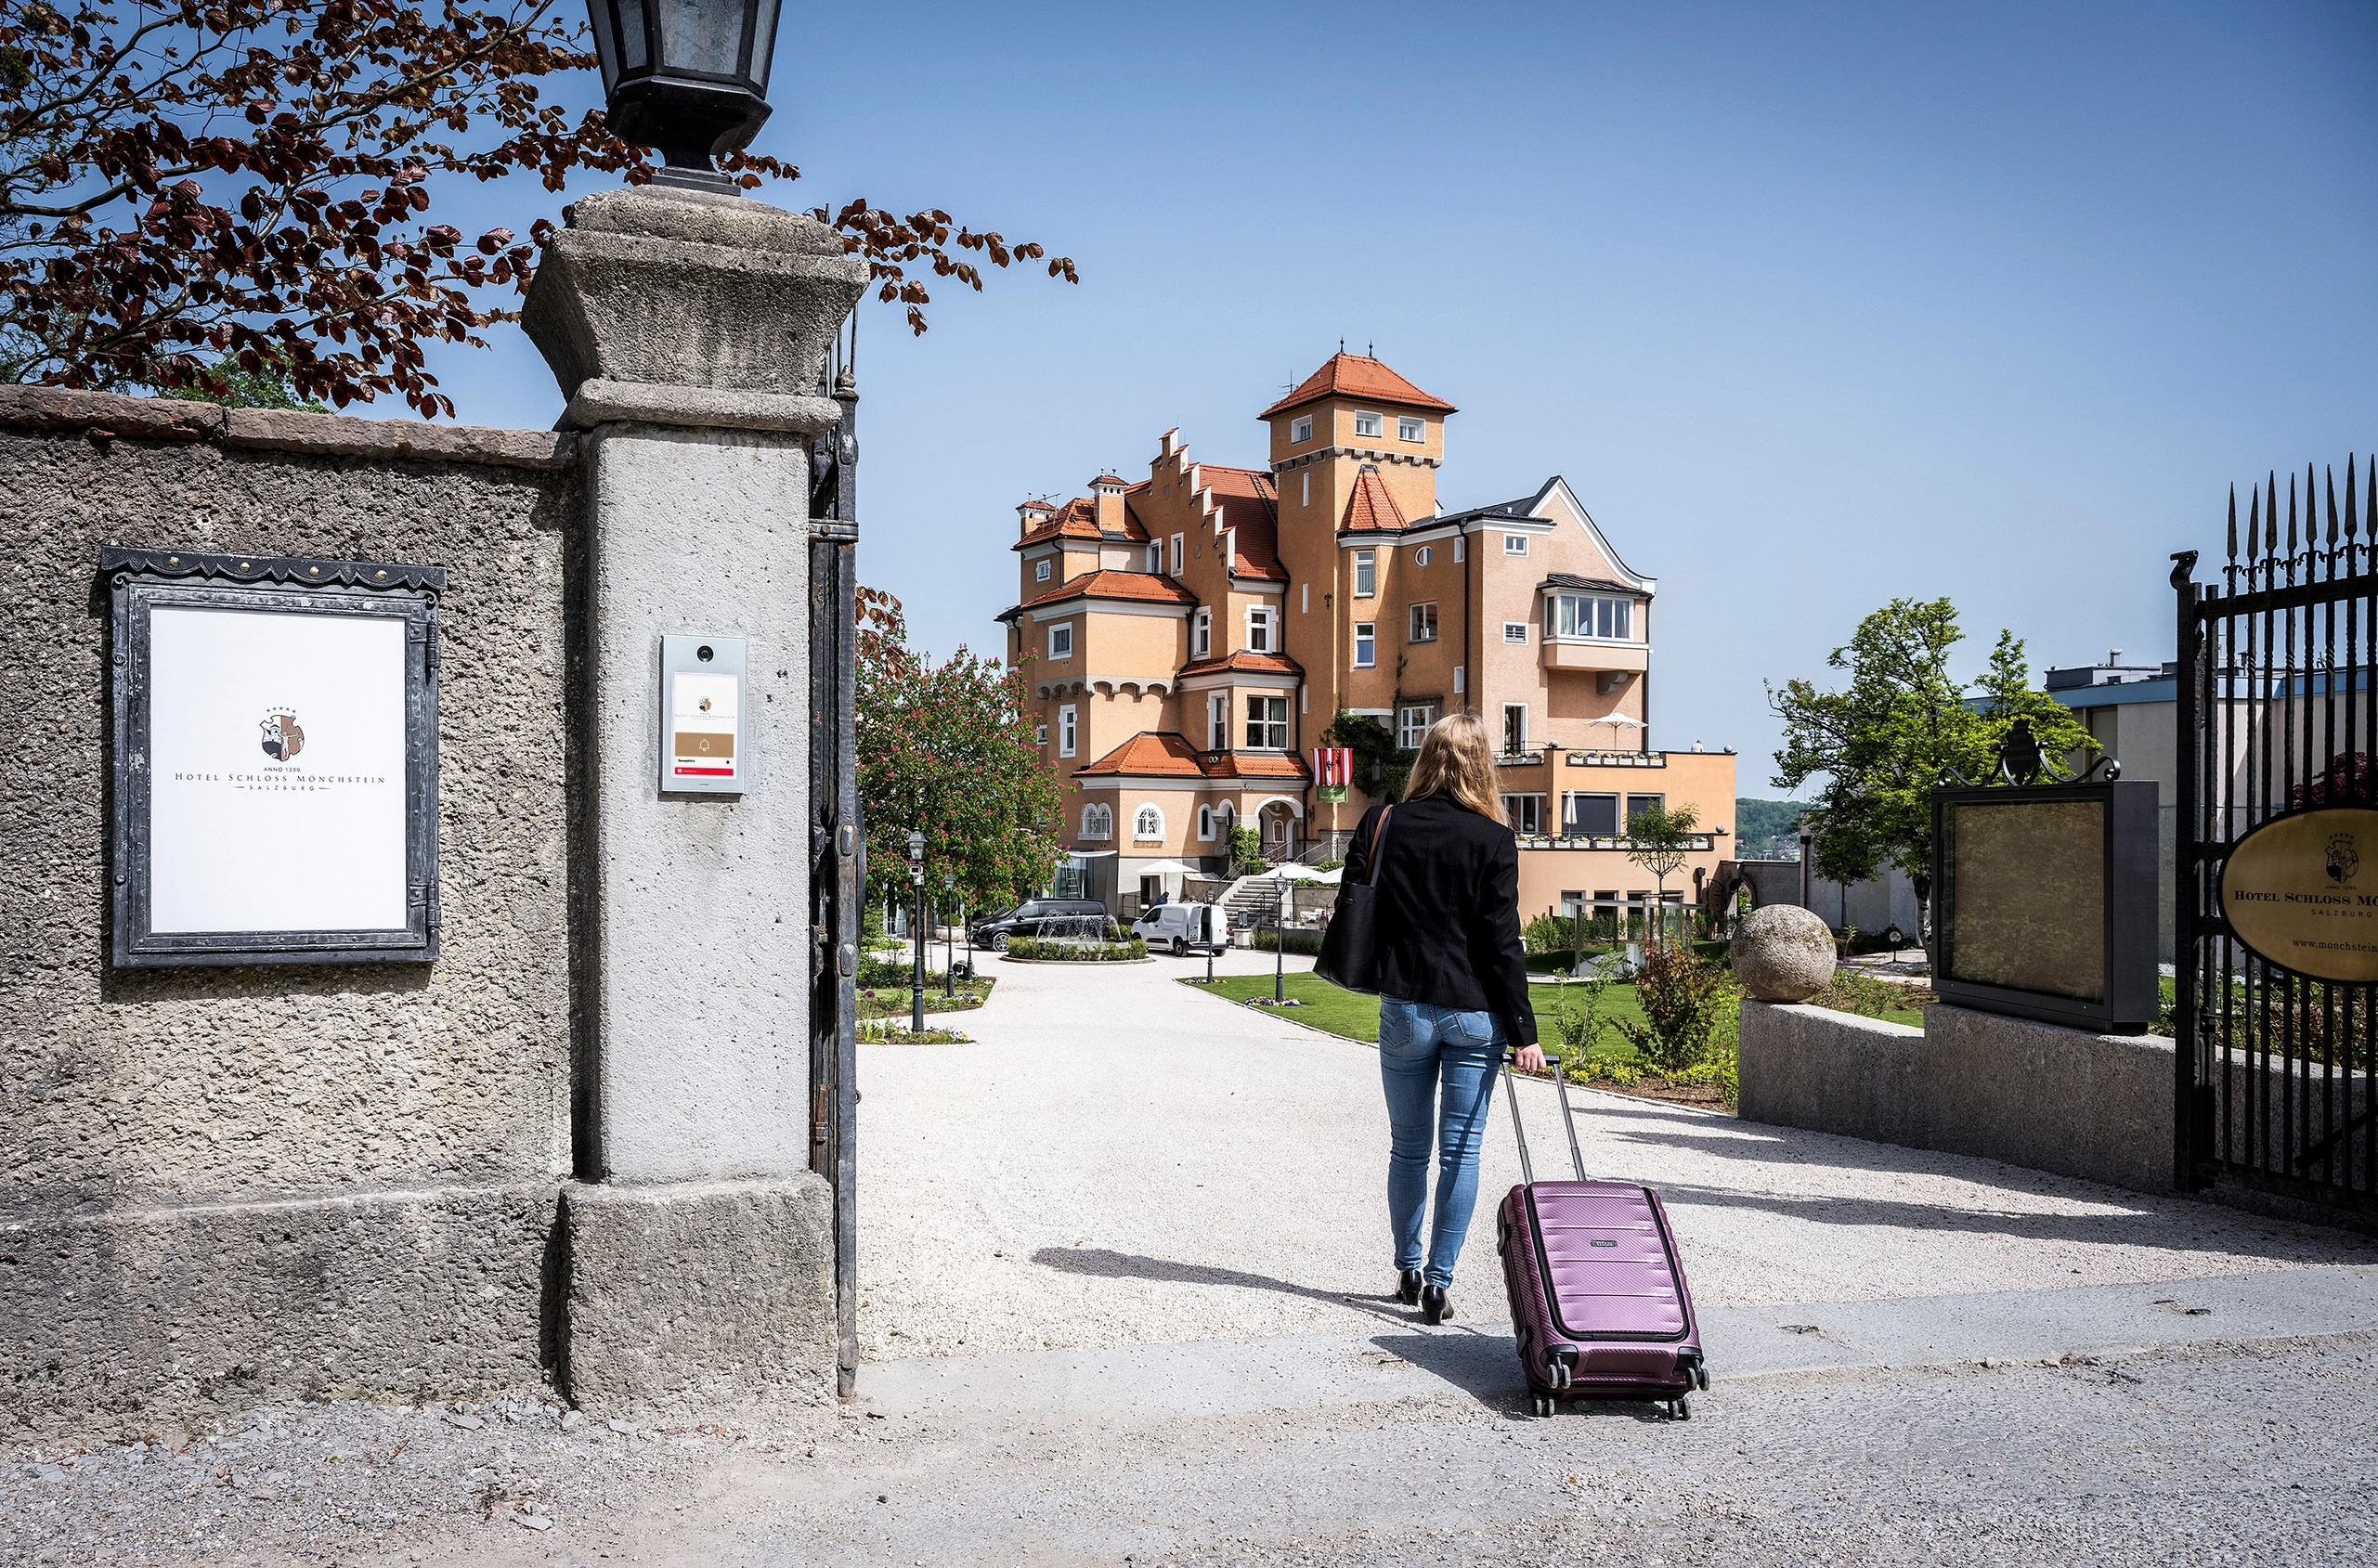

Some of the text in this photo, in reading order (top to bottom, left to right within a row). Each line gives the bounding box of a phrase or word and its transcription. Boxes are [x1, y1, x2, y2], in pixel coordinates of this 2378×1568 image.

[175, 772, 219, 781] HOTEL
[228, 773, 287, 783] SCHLOSS
[2234, 890, 2281, 902] HOTEL
[2284, 891, 2351, 905] SCHLOSS
[2310, 908, 2372, 918] SALZBURG
